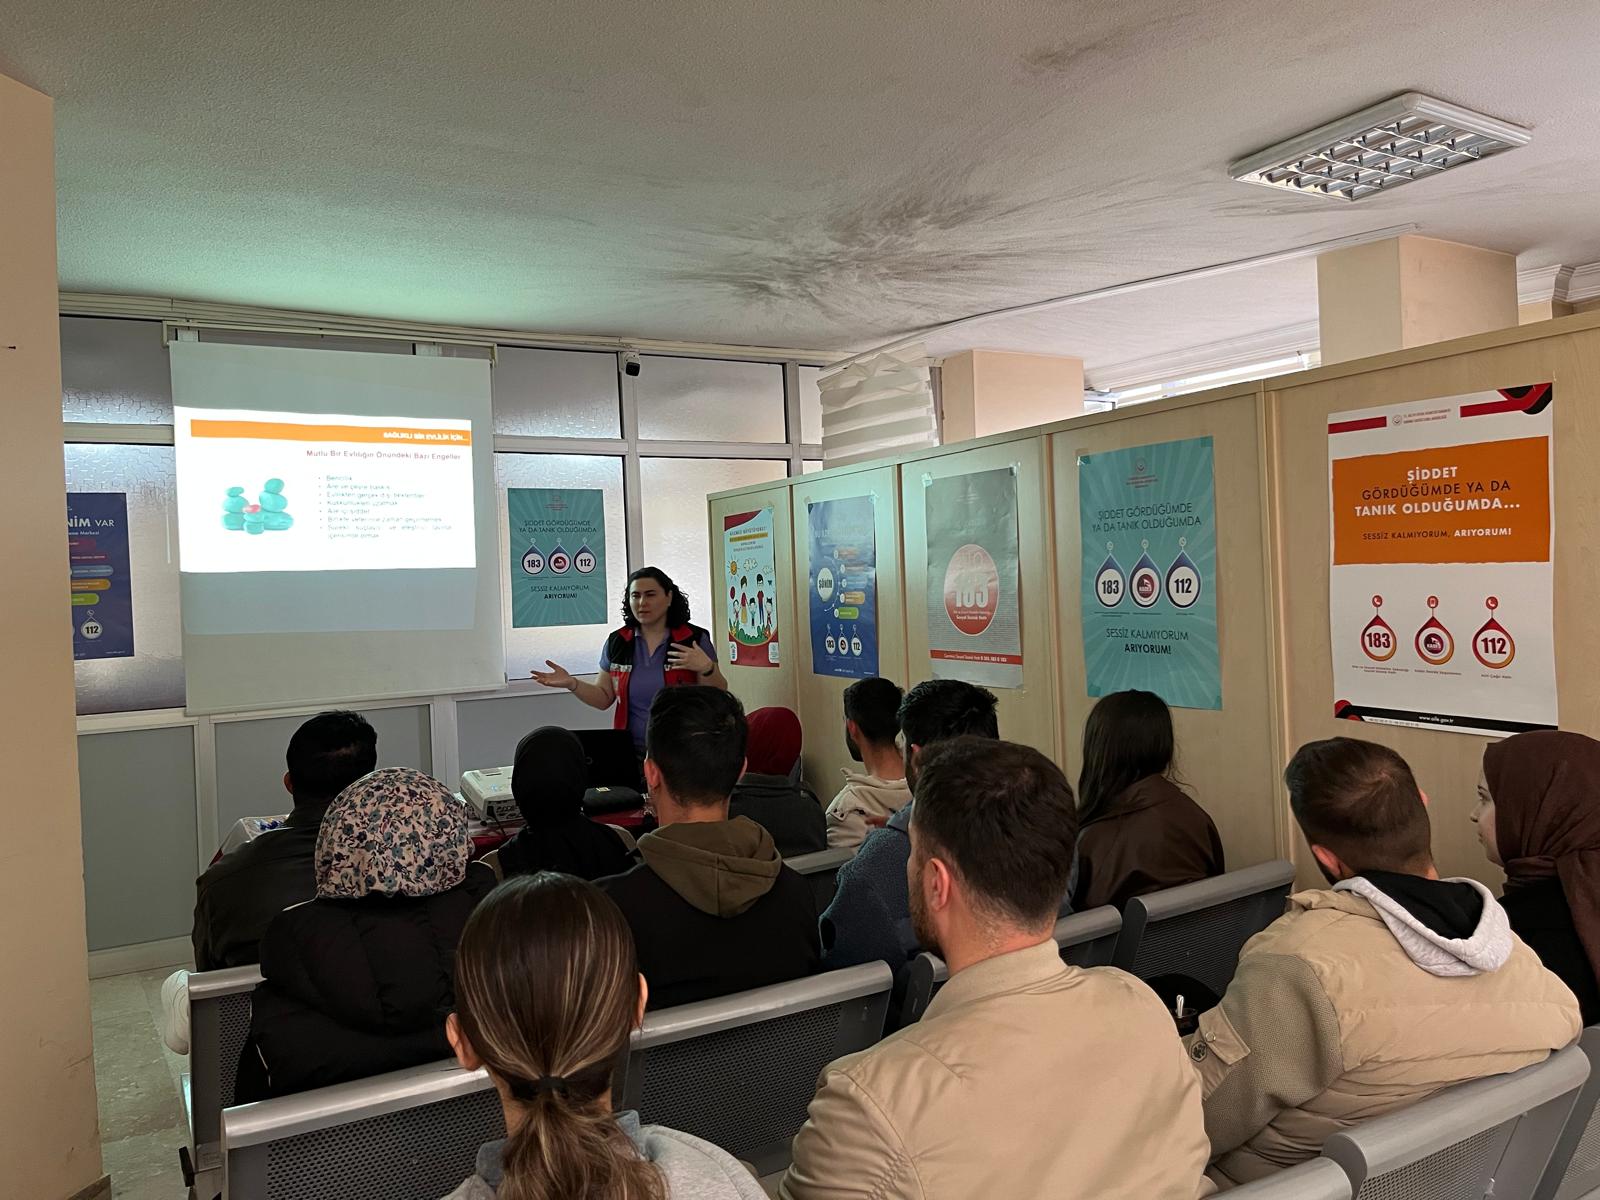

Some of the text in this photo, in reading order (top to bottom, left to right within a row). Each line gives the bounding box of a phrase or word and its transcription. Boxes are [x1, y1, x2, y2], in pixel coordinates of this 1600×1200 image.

[431, 453, 461, 461] Engeller
[1406, 466, 1458, 484] ŞİDDET
[1362, 480, 1511, 501] GÖRDÜĞÜMDE YA DA
[1097, 502, 1193, 521] ŞİDDET GÖRDÜĞÜMDE
[1355, 497, 1521, 517] TANIK OLDUĞUMDA...
[95, 519, 115, 527] VAR
[1092, 516, 1202, 533] YA DA TANIK OLDUĞUMDA
[1362, 531, 1389, 541] SESSİZ
[1453, 527, 1512, 538] ARIYORUM!
[526, 559, 541, 568] 183
[579, 558, 591, 567] 112
[1101, 579, 1120, 595] 183
[1173, 577, 1193, 594] 112
[85, 625, 99, 634] 112
[1105, 627, 1189, 641] SESSİZ KALMIYORUM
[1366, 632, 1391, 649] 183
[1480, 637, 1507, 655] 112
[1124, 643, 1171, 655] ARIYORUM!
